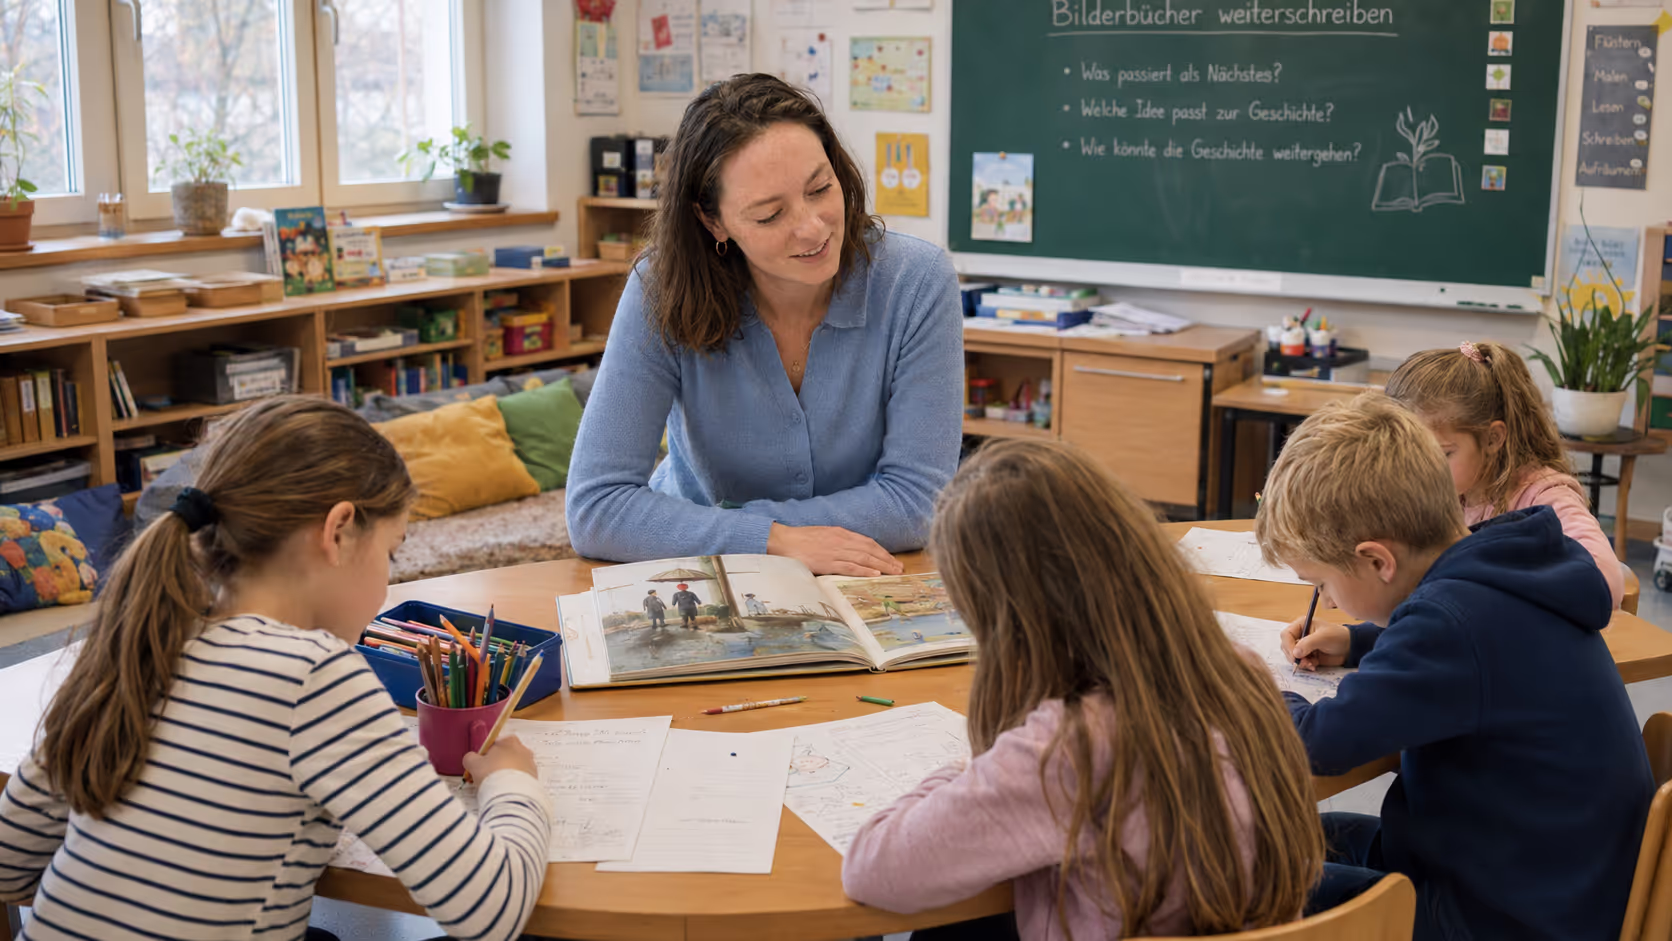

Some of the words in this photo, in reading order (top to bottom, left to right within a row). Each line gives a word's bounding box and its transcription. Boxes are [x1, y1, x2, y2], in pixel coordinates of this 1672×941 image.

[1053, 0, 1202, 26] Bilderbücher
[1218, 0, 1393, 25] weiterschreiben
[1594, 35, 1642, 49] Flüstern
[1081, 61, 1110, 81] Was
[1118, 63, 1172, 89] passiert
[1180, 63, 1200, 82] als
[1207, 62, 1283, 83] Nächstes?
[1594, 70, 1628, 83] Malen
[1081, 99, 1128, 118] Welche
[1135, 99, 1166, 119] Idee
[1171, 102, 1208, 126] passt
[1216, 109, 1240, 120] zur
[1248, 100, 1335, 122] Geschichte?
[1592, 100, 1624, 113] Lesen
[1582, 131, 1635, 145] Schreiben
[1081, 137, 1106, 156] Wie
[1113, 137, 1157, 158] könnte
[1162, 138, 1183, 158] die
[1191, 138, 1264, 160] Geschichte
[1272, 141, 1362, 168] weitergehen?
